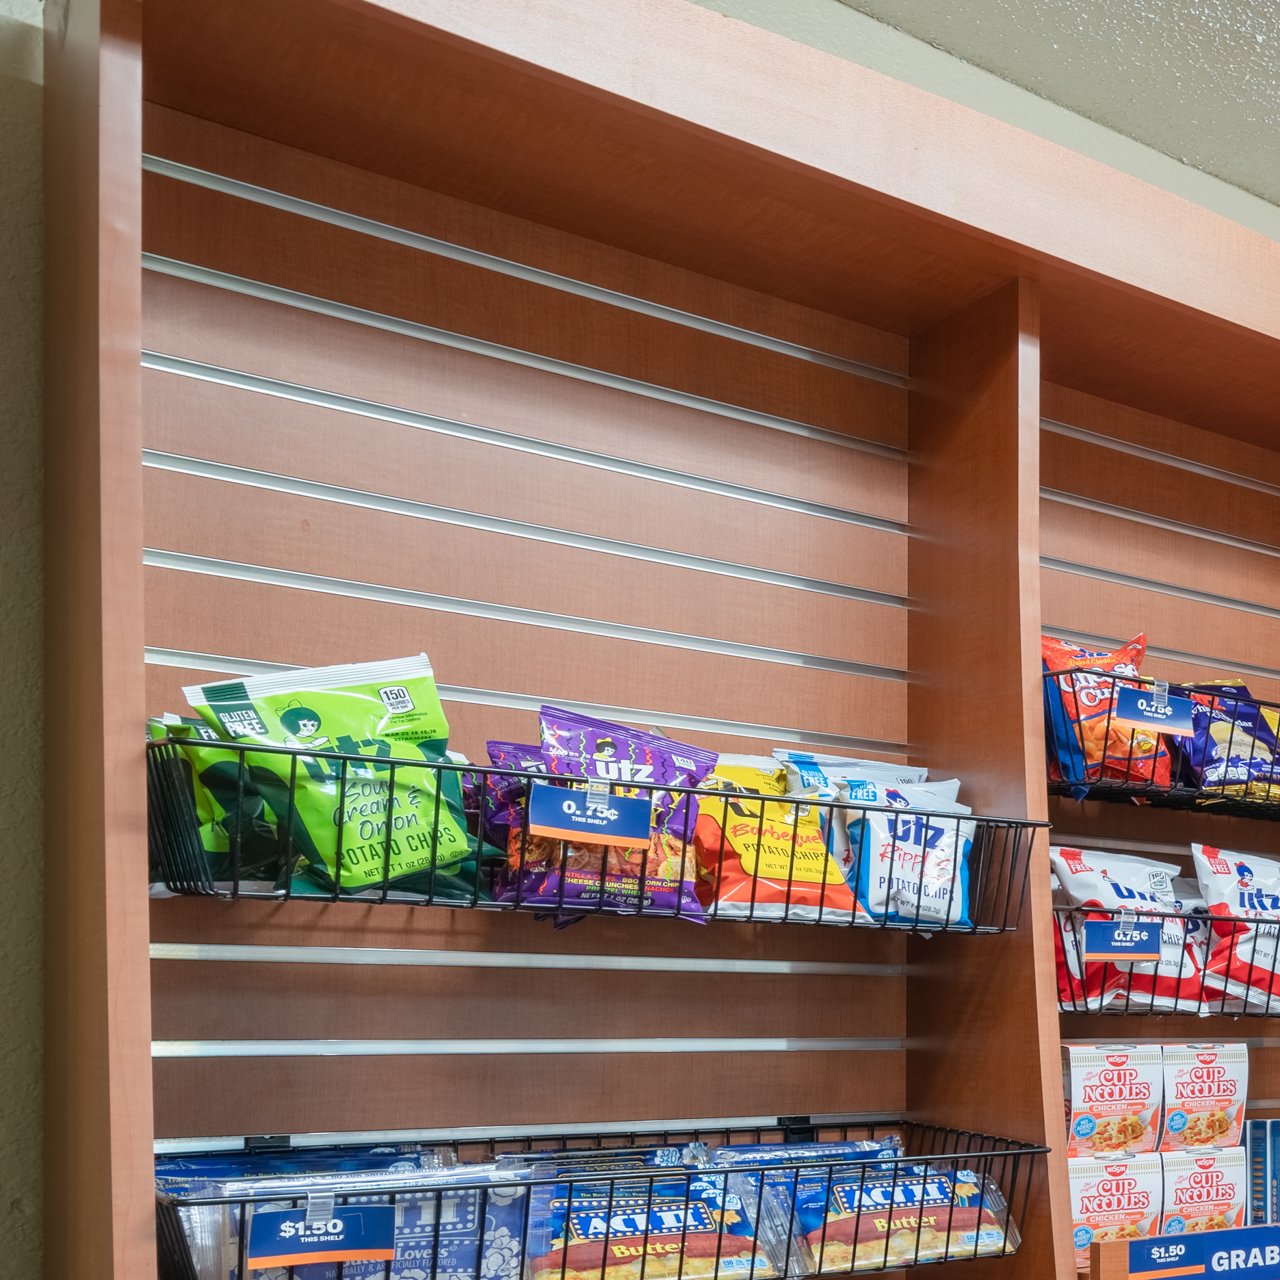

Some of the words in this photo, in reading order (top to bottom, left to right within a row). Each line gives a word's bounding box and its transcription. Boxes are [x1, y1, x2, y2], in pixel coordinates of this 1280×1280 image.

[382, 688, 406, 700] 150
[1137, 699, 1173, 716] 0.75¢
[219, 710, 257, 723] GLUTEN
[595, 760, 654, 783] utz
[851, 788, 875, 801] FREE
[886, 815, 945, 850] utz
[1212, 863, 1230, 874] FREE
[1114, 929, 1149, 942] 0.75¢
[1099, 1069, 1137, 1086] CUP
[1189, 1067, 1225, 1083] CUP
[1083, 1083, 1150, 1103] NOODLES
[1176, 1079, 1236, 1099] NOODLES
[1097, 1178, 1137, 1196] CUP
[1189, 1172, 1223, 1188] CUP
[853, 1187, 905, 1206] ACT
[910, 1184, 943, 1201] II
[1081, 1192, 1150, 1214] NOODLES
[1175, 1185, 1236, 1204] NOODLES
[280, 1218, 344, 1239] $1.50
[588, 1212, 653, 1235] ACT
[656, 1208, 698, 1229] II
[873, 1215, 936, 1232] Butter
[320, 1234, 345, 1242] SHELF
[611, 1240, 689, 1258] Butter
[1151, 1244, 1185, 1259] $1.50
[1211, 1246, 1280, 1273] GRAB
